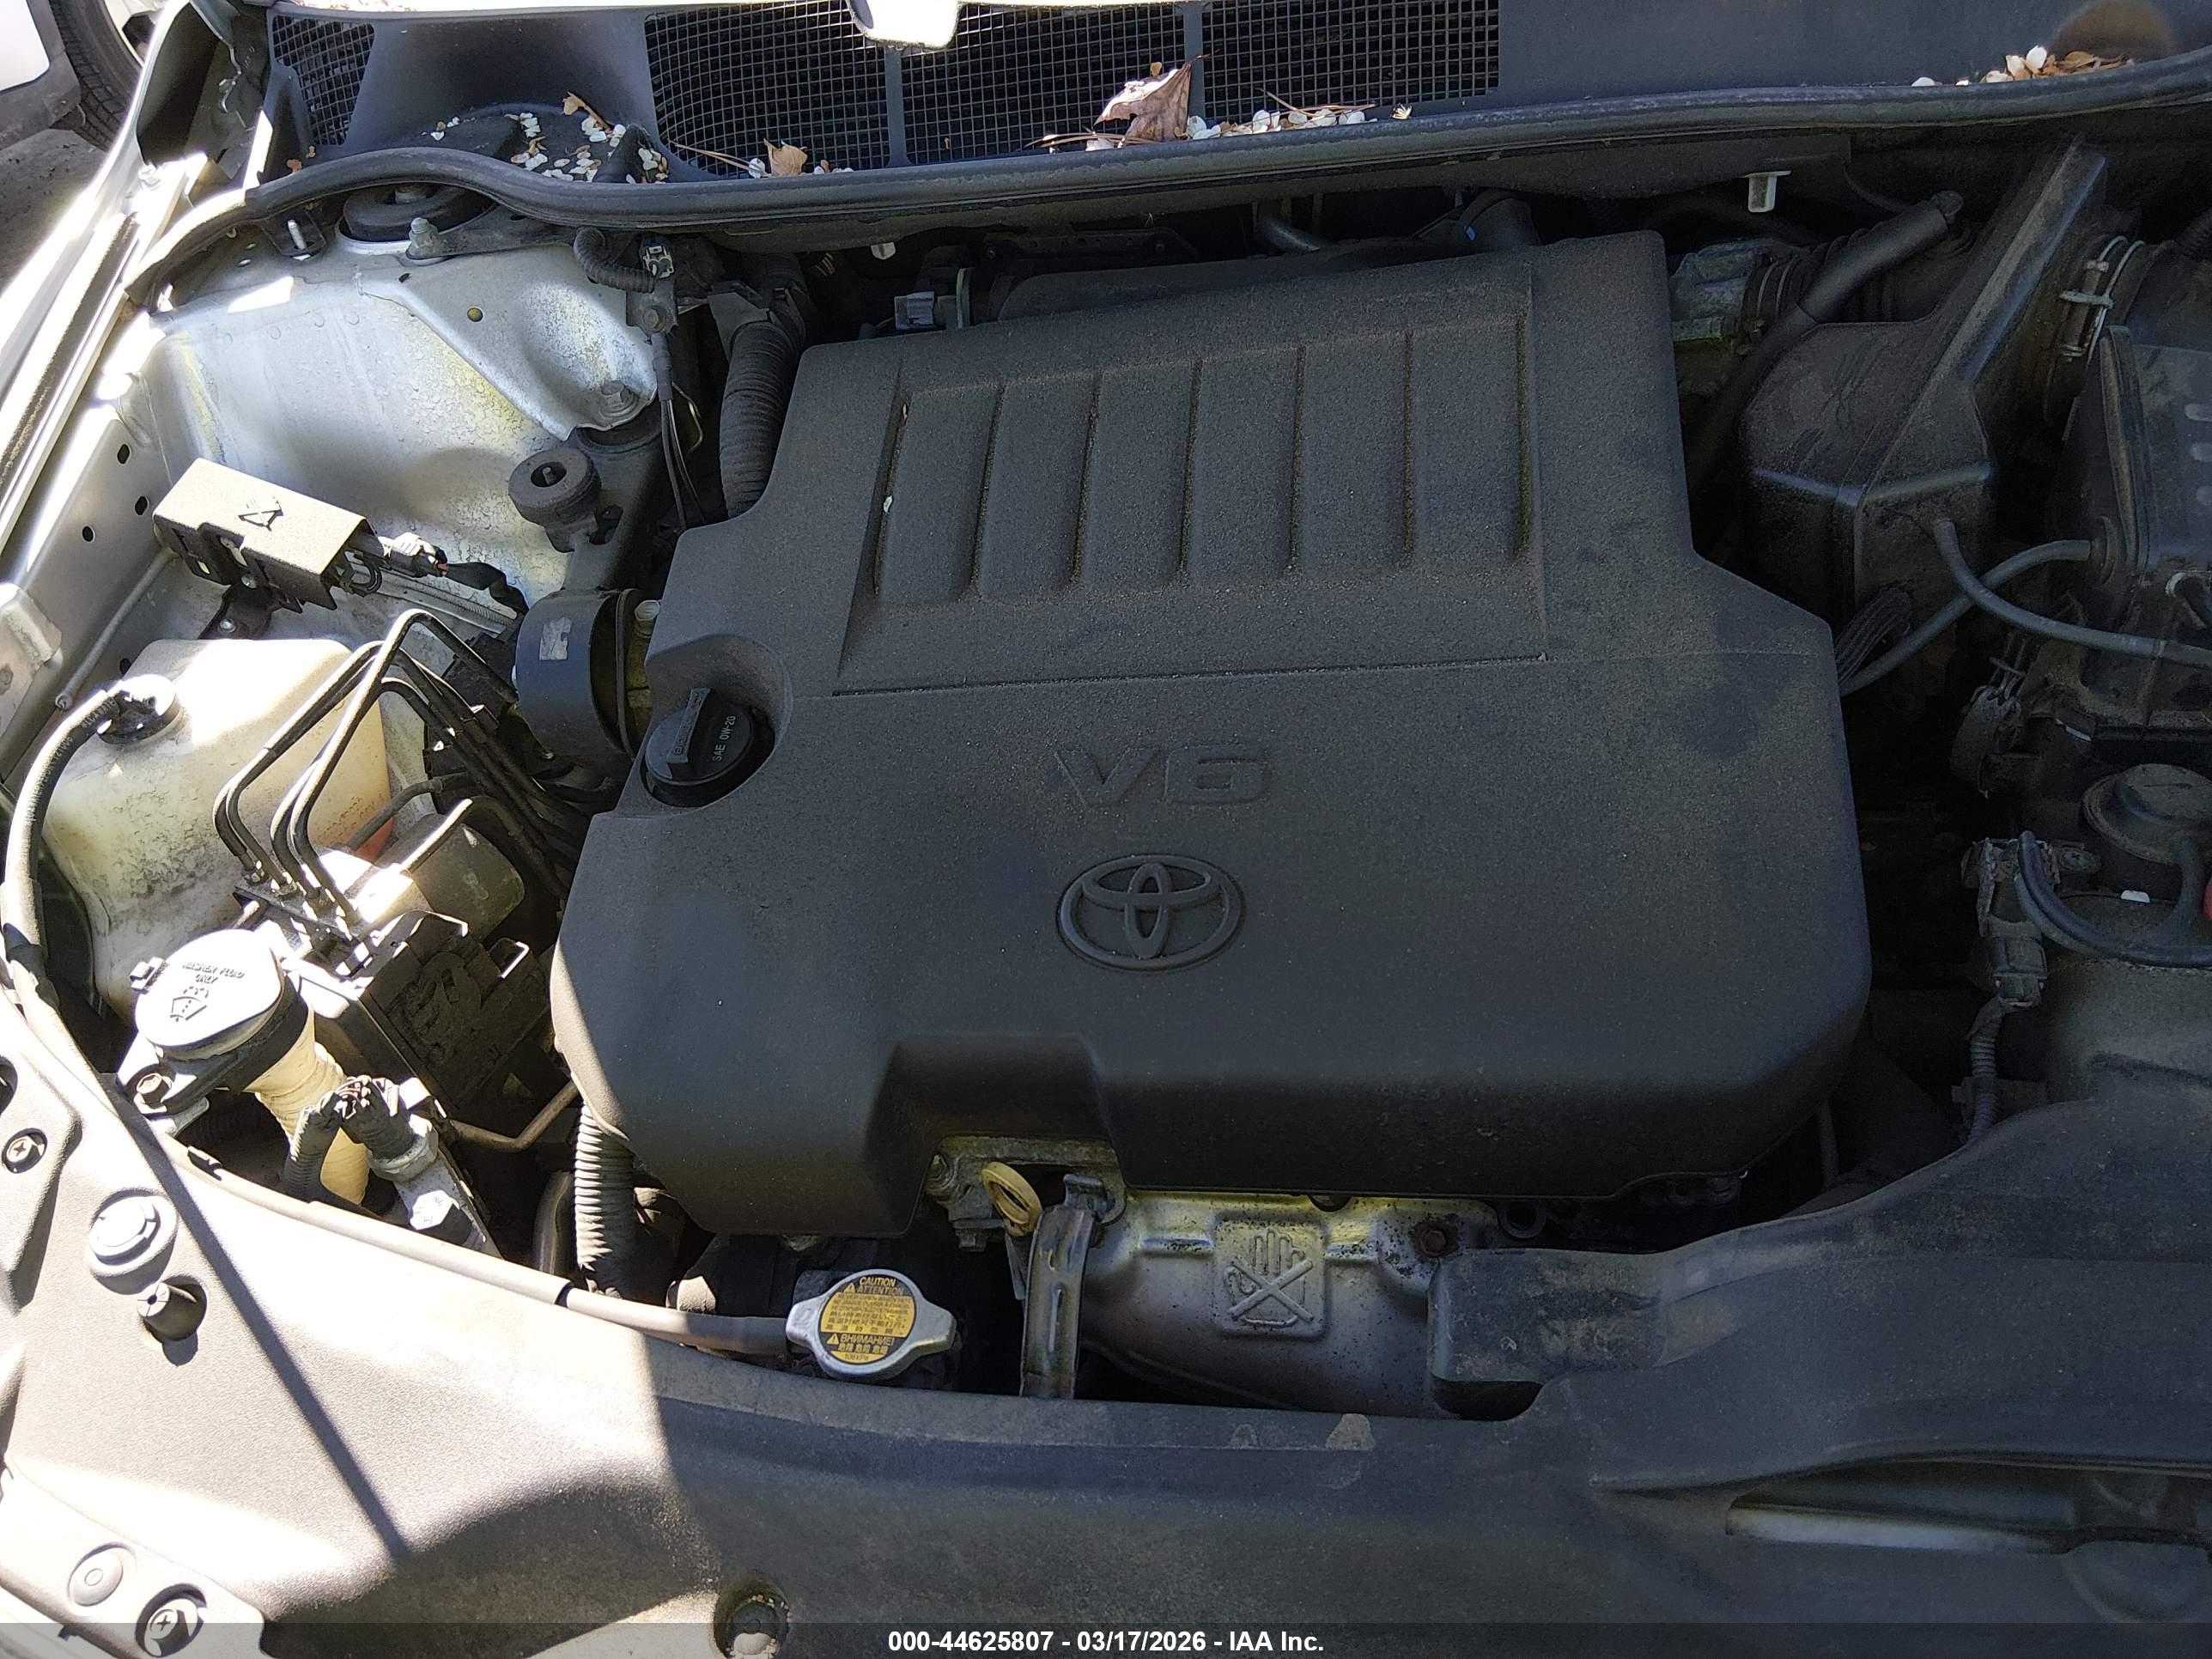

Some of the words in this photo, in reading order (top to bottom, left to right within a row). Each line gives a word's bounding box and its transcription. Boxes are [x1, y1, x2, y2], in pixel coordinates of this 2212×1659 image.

[712, 744, 726, 762] SAE
[719, 715, 736, 739] 0W-20
[1053, 745, 1271, 805] V6
[196, 974, 219, 984] ONLY
[860, 1276, 896, 1287] CAUTION
[857, 1285, 904, 1296] ATTENTION
[840, 1334, 895, 1346] ВНИМАНИЕ!
